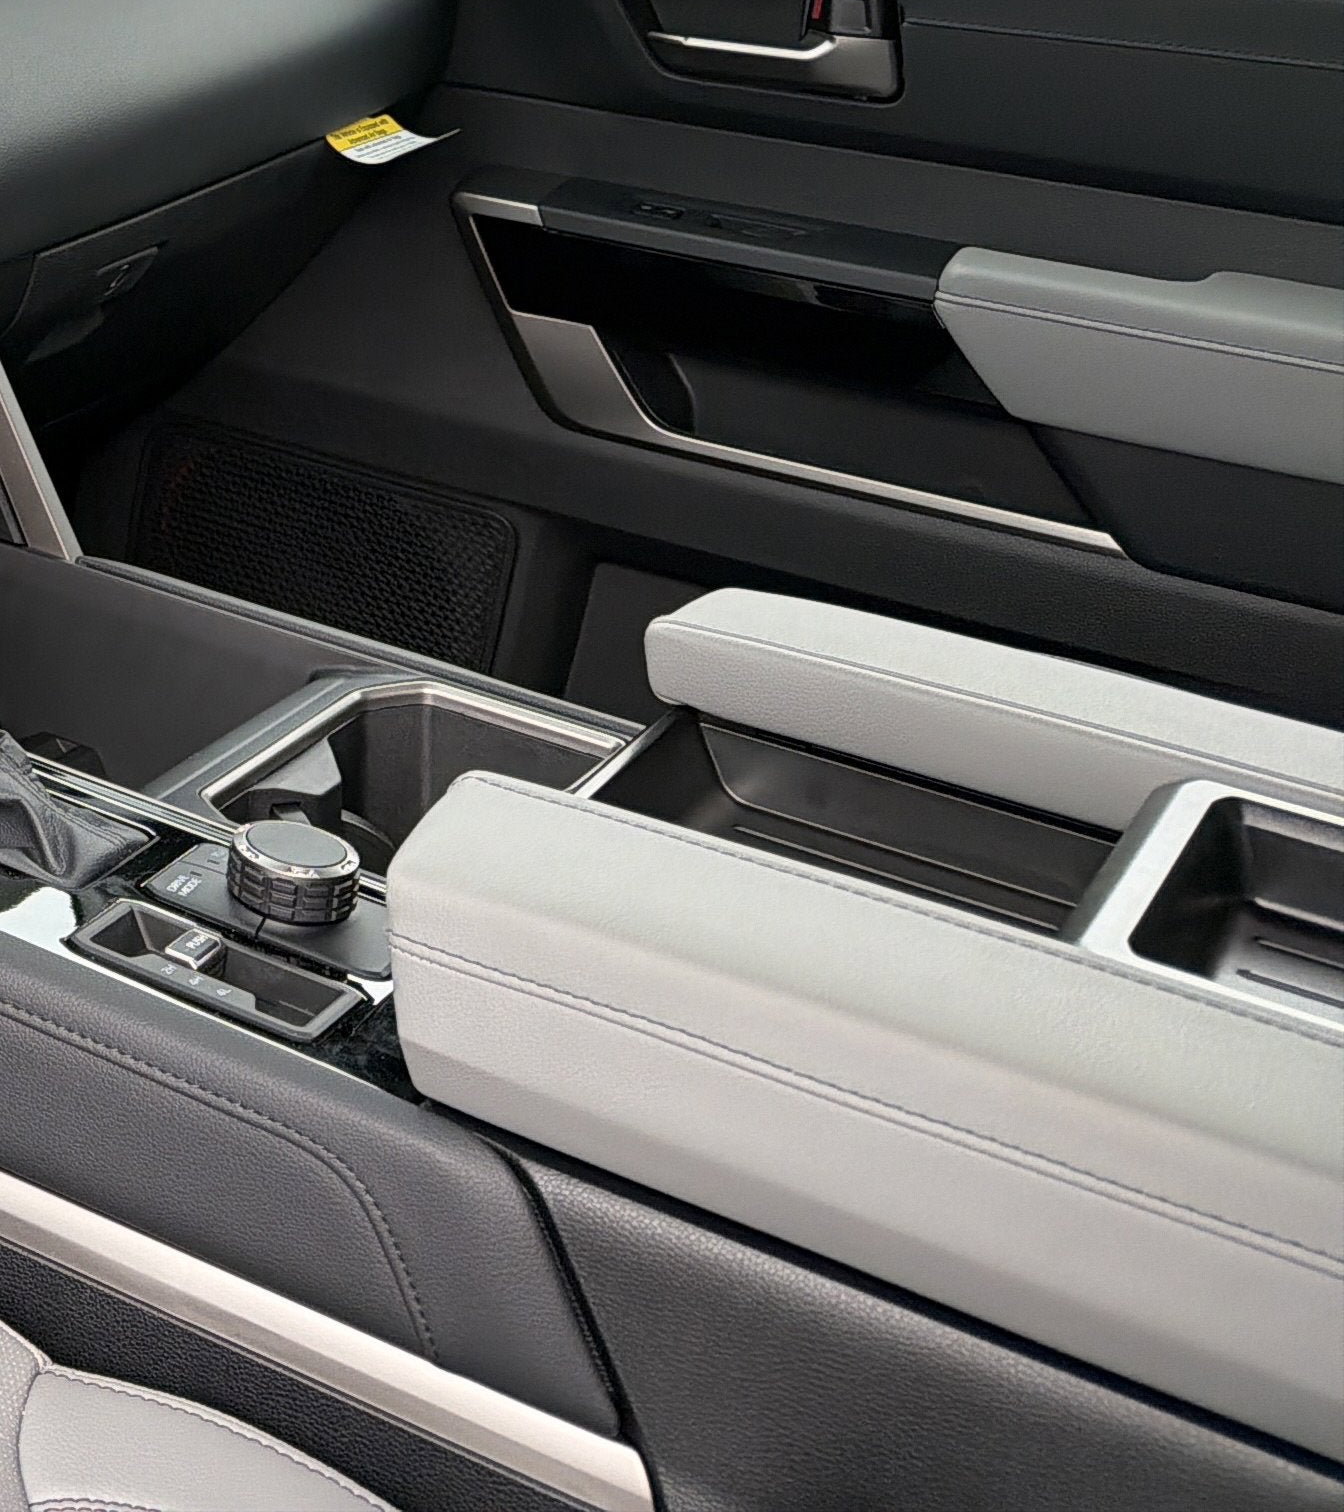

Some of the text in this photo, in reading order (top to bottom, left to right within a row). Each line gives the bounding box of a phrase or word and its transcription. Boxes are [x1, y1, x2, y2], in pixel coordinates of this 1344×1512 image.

[185, 934, 210, 950] PUSH
[160, 963, 177, 976] 2H
[216, 987, 233, 997] 4L
